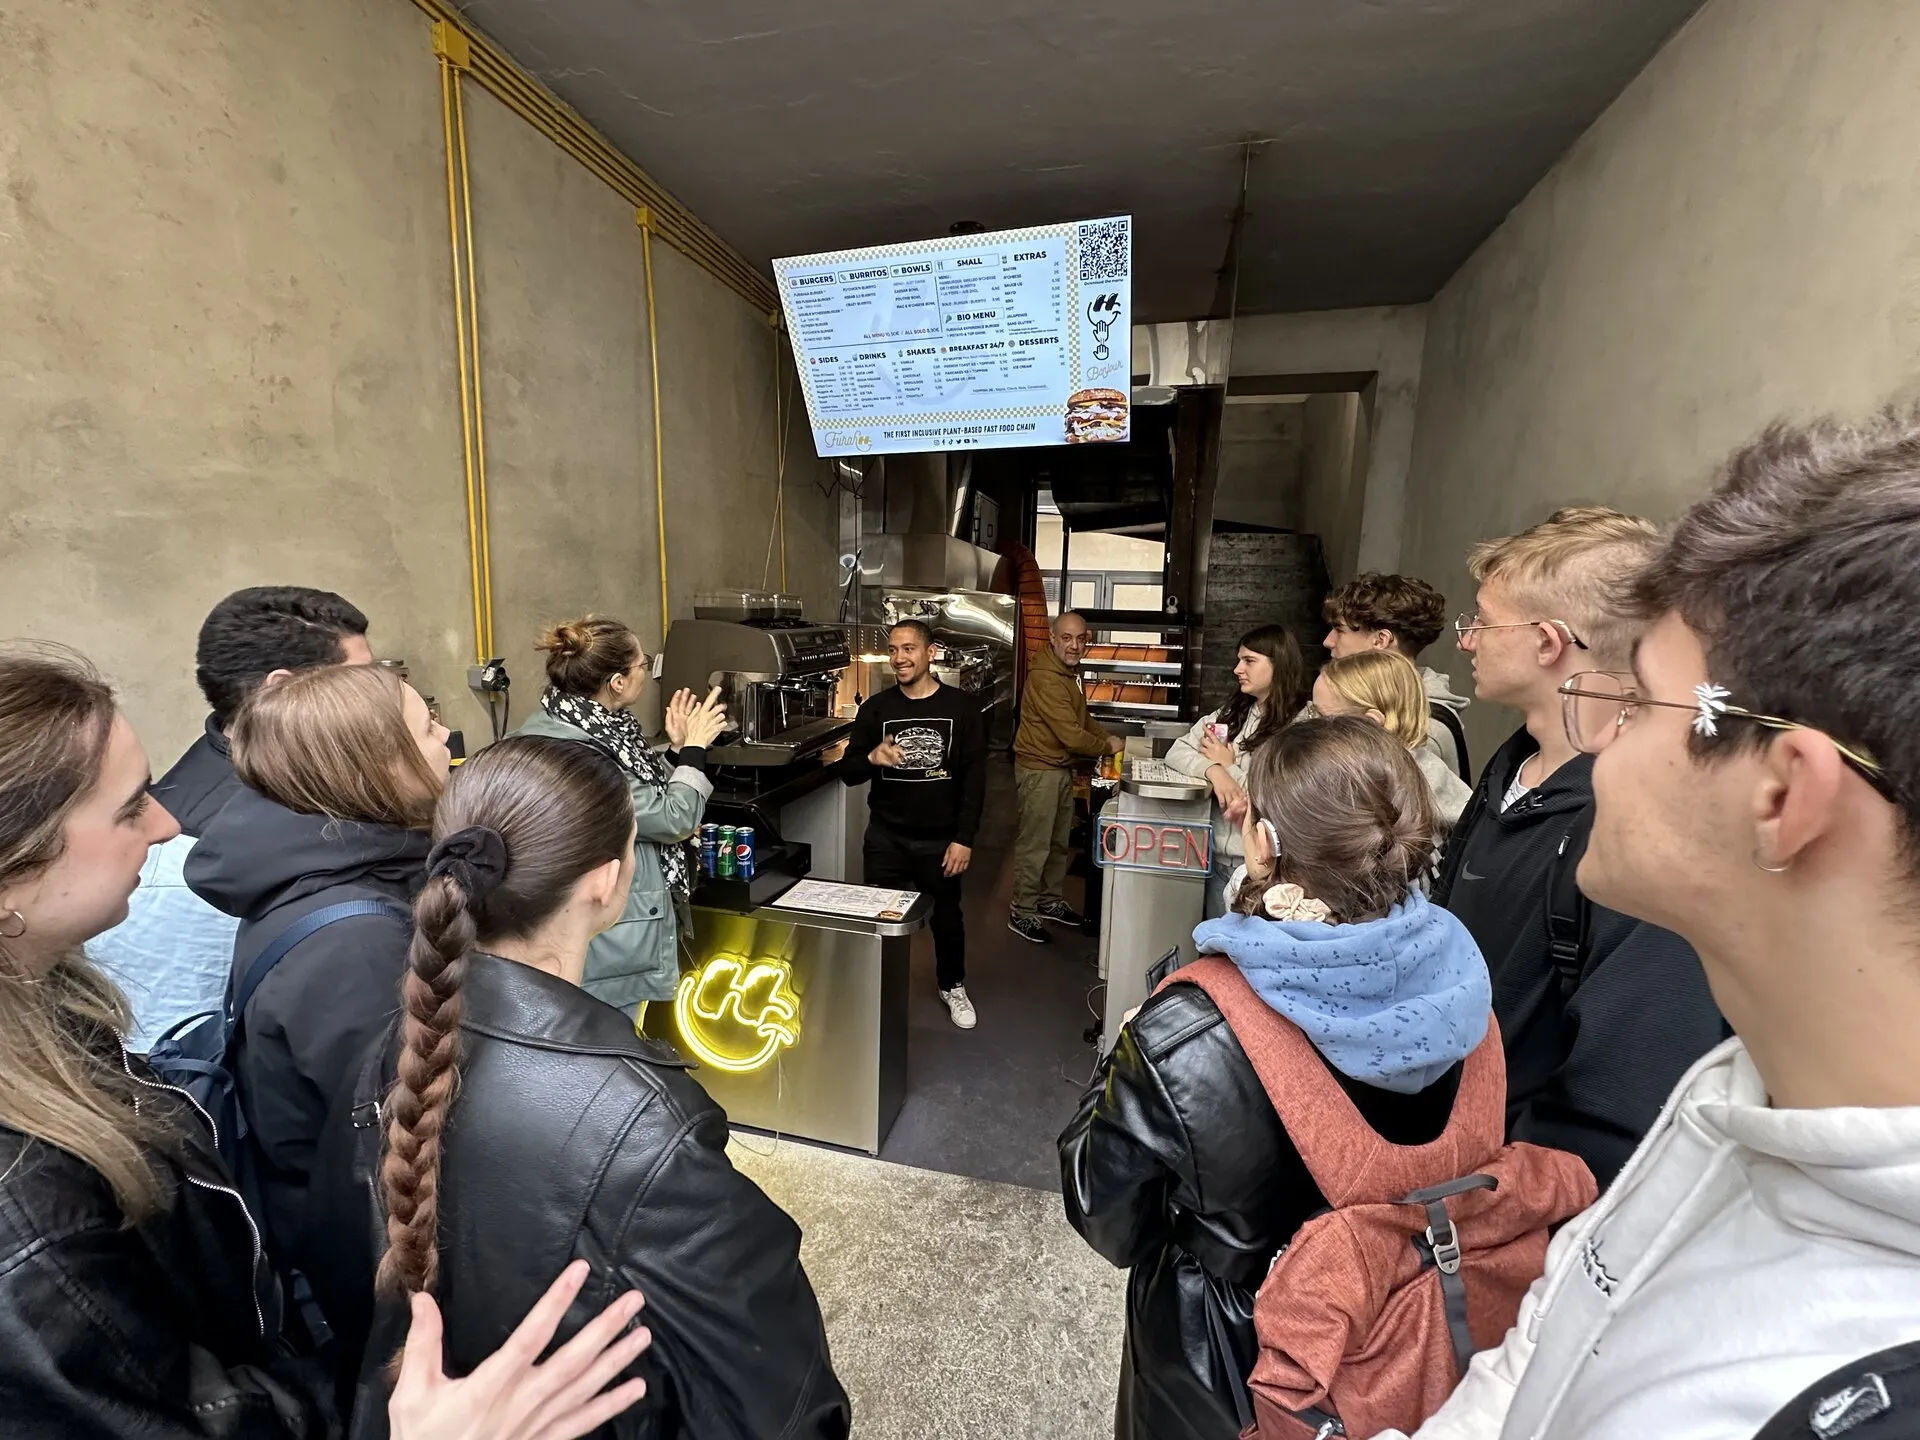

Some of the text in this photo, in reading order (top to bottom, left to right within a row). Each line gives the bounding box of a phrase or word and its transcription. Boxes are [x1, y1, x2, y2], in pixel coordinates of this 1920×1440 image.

[1014, 251, 1046, 262] EXTRAS
[957, 258, 982, 266] SMALL
[902, 264, 930, 274] BOWLS
[849, 269, 888, 280] BURRITOS
[800, 276, 834, 286] BURGERS
[973, 311, 995, 320] MENU
[1019, 337, 1059, 346] DESSERTS
[906, 348, 936, 356] SHAKES
[949, 343, 988, 352] BREAKFAST
[1087, 361, 1123, 381] Bonjour
[912, 429, 941, 437] INCLUSIVE
[943, 426, 982, 435] PLANT-BASED
[1102, 823, 1209, 870] OPEN
